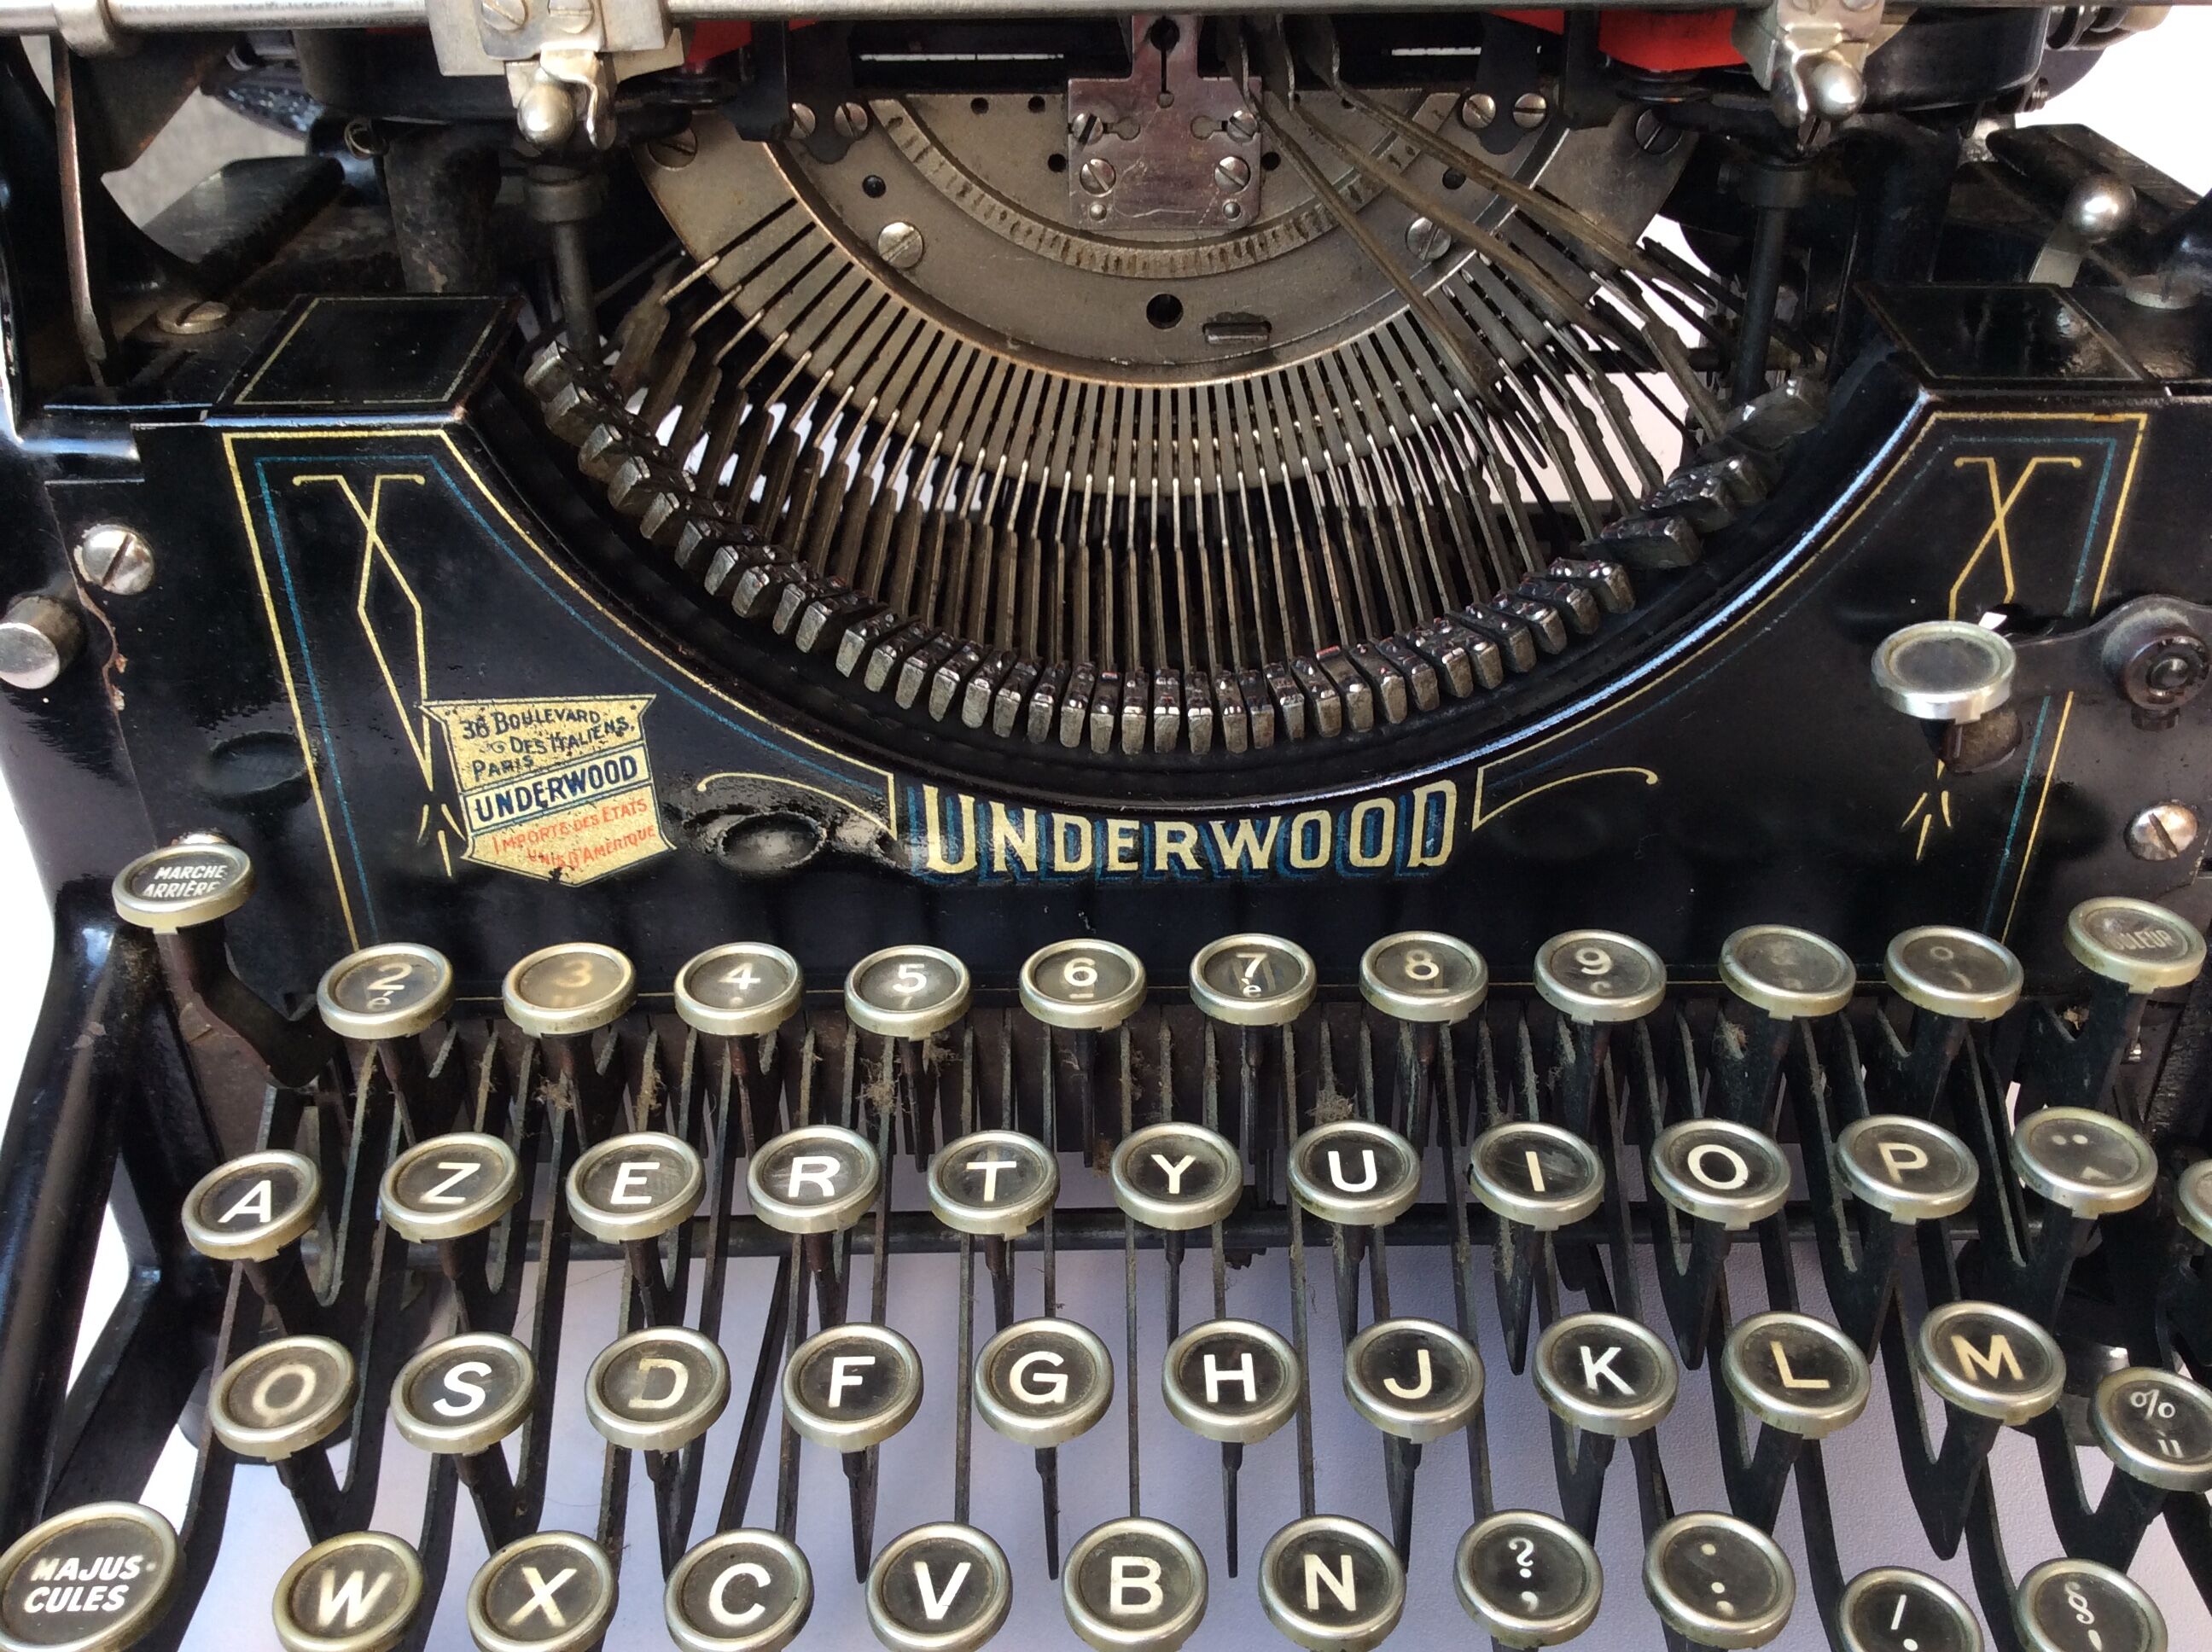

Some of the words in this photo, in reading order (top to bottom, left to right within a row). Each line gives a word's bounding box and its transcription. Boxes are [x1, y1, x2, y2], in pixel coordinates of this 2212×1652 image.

[491, 708, 601, 735] BOULEVARD
[509, 736, 547, 754] DES
[472, 754, 534, 782] PARIS
[475, 755, 638, 823] UNDERWOOD
[911, 778, 1458, 879] UNDERWOOD
[154, 864, 228, 881] MARCHE
[367, 962, 413, 990] 2
[555, 959, 593, 988] 3
[717, 962, 761, 990] 4
[892, 963, 928, 994] 5
[1063, 957, 1098, 987] 6
[1236, 951, 1268, 978] 7
[1405, 949, 1441, 980] 8
[1575, 946, 1612, 975] 9
[419, 1161, 481, 1204] Z
[608, 1161, 661, 1205] E
[787, 1155, 841, 1198] R
[965, 1160, 1017, 1202] T
[1150, 1154, 1196, 1195] Y
[1327, 1149, 1378, 1193] U
[1524, 1150, 1545, 1192] I
[1686, 1143, 1749, 1190] O
[1877, 1142, 1929, 1184] P
[218, 1179, 272, 1224] A
[1009, 1351, 1068, 1405] G
[1202, 1352, 1258, 1403] H
[1382, 1348, 1432, 1400] J
[1579, 1345, 1636, 1396] K
[1769, 1340, 1831, 1389] L
[1950, 1334, 2025, 1381] M
[432, 1361, 493, 1416] S
[627, 1358, 689, 1410] D
[827, 1355, 876, 1409] F
[23, 1584, 131, 1614] CULES
[313, 1568, 396, 1628] W
[508, 1567, 578, 1626] X
[707, 1562, 772, 1625] C
[911, 1561, 972, 1620] V
[1109, 1555, 1165, 1615] B
[1302, 1553, 1358, 1612] N
